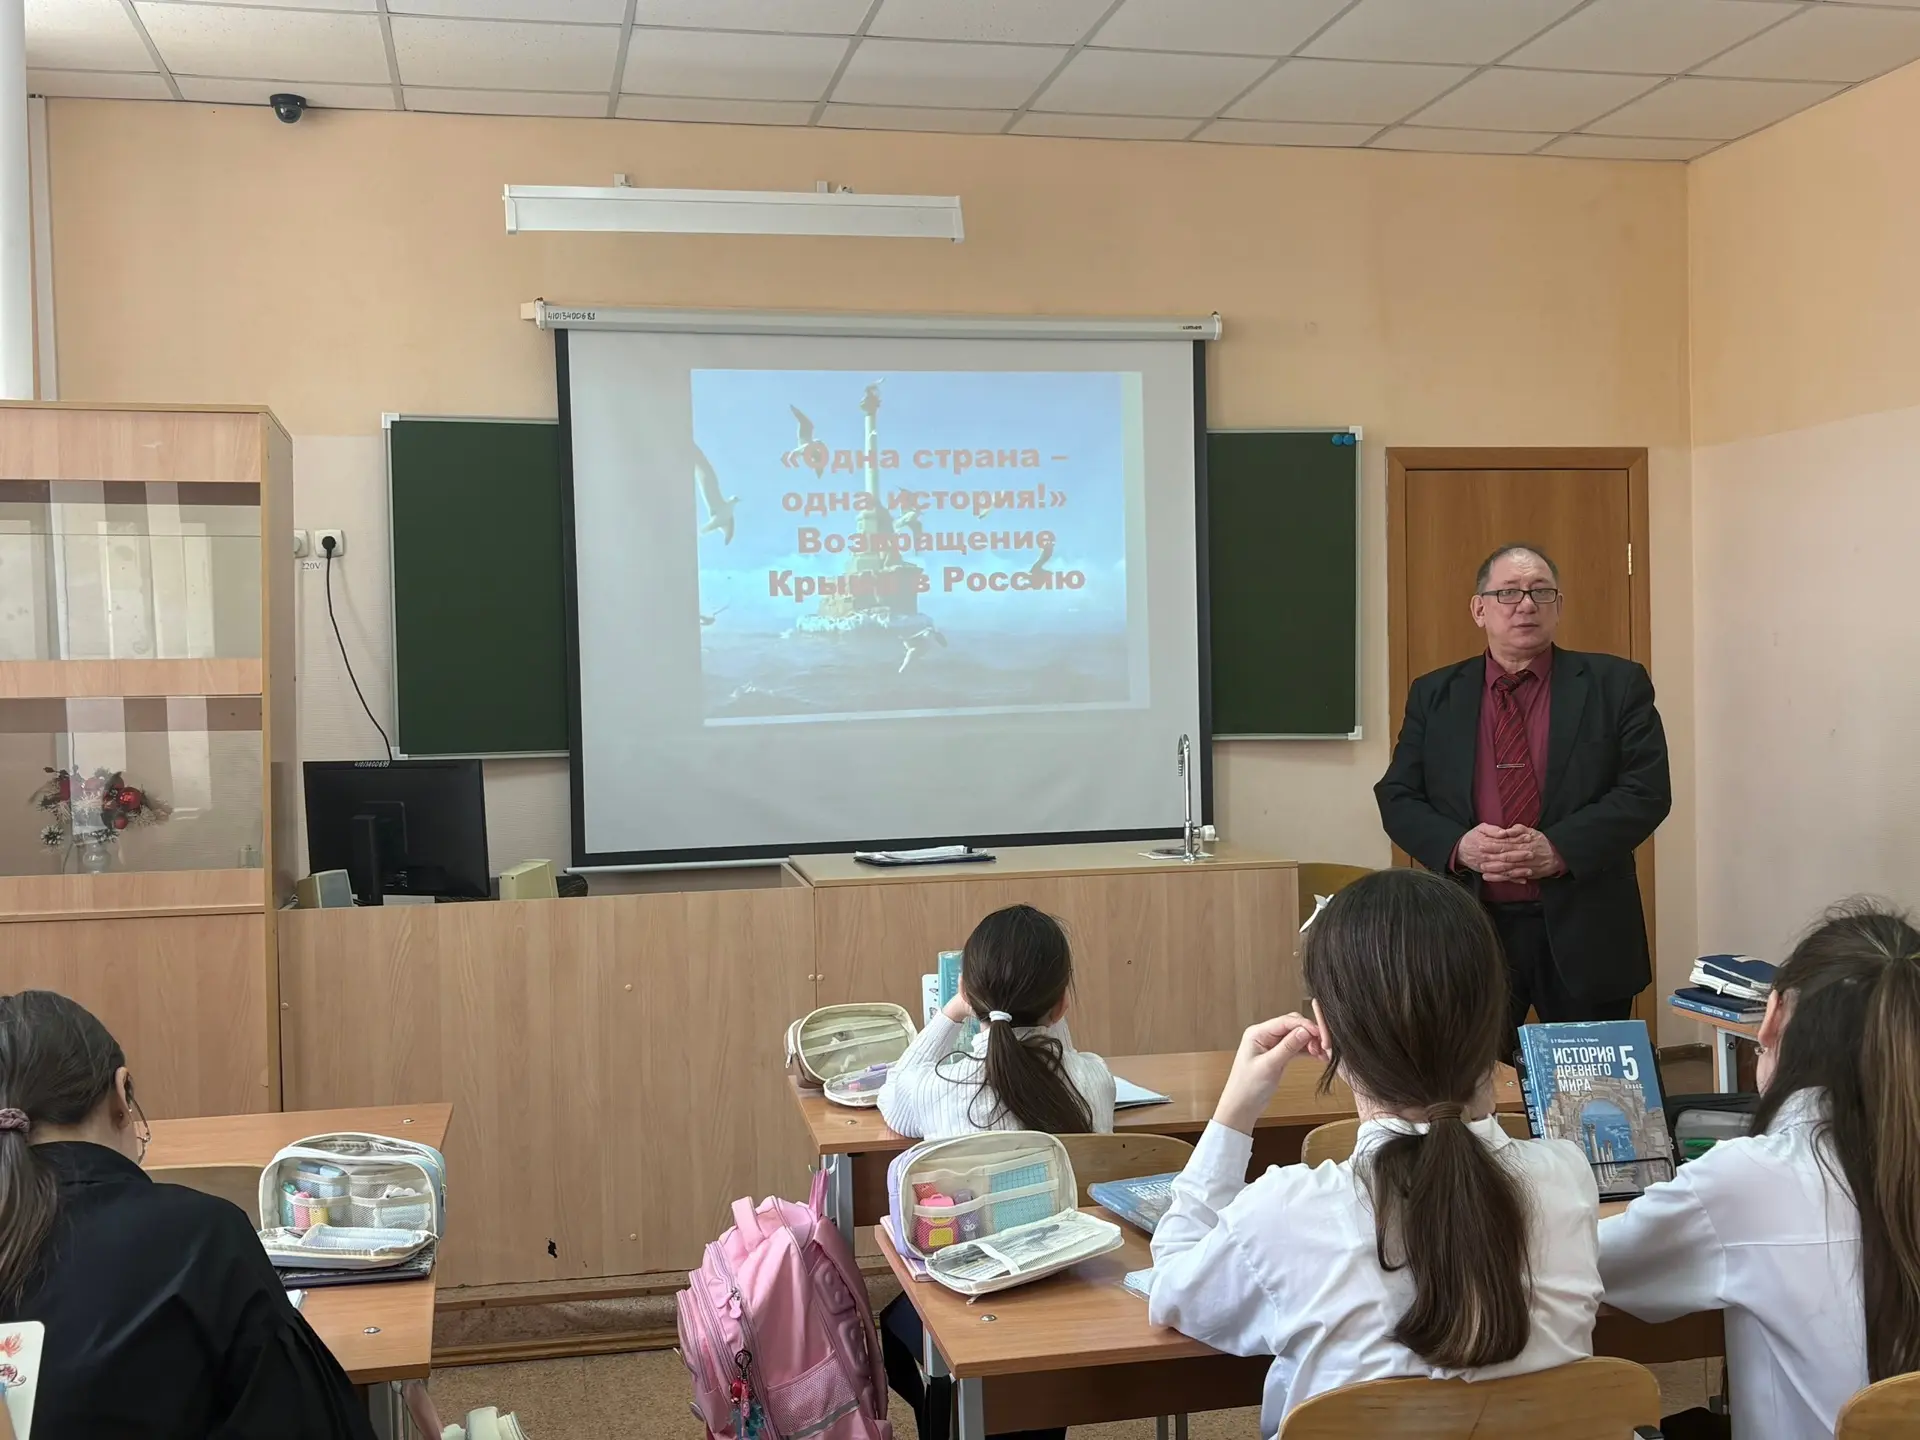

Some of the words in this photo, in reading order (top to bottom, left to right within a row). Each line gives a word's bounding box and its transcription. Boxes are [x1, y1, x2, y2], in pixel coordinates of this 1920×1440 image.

[780, 440, 900, 475] «Одна
[912, 447, 1041, 476] страна
[781, 489, 875, 518] одна
[886, 482, 1068, 517] история!»
[797, 527, 1056, 561] Возвращение
[943, 565, 1086, 593] Россию
[1552, 1046, 1616, 1064] ИСТОРИЯ
[1618, 1044, 1640, 1082] 5
[1556, 1062, 1613, 1080] ДРЕВНЕГО
[1557, 1078, 1593, 1093] МИРА
